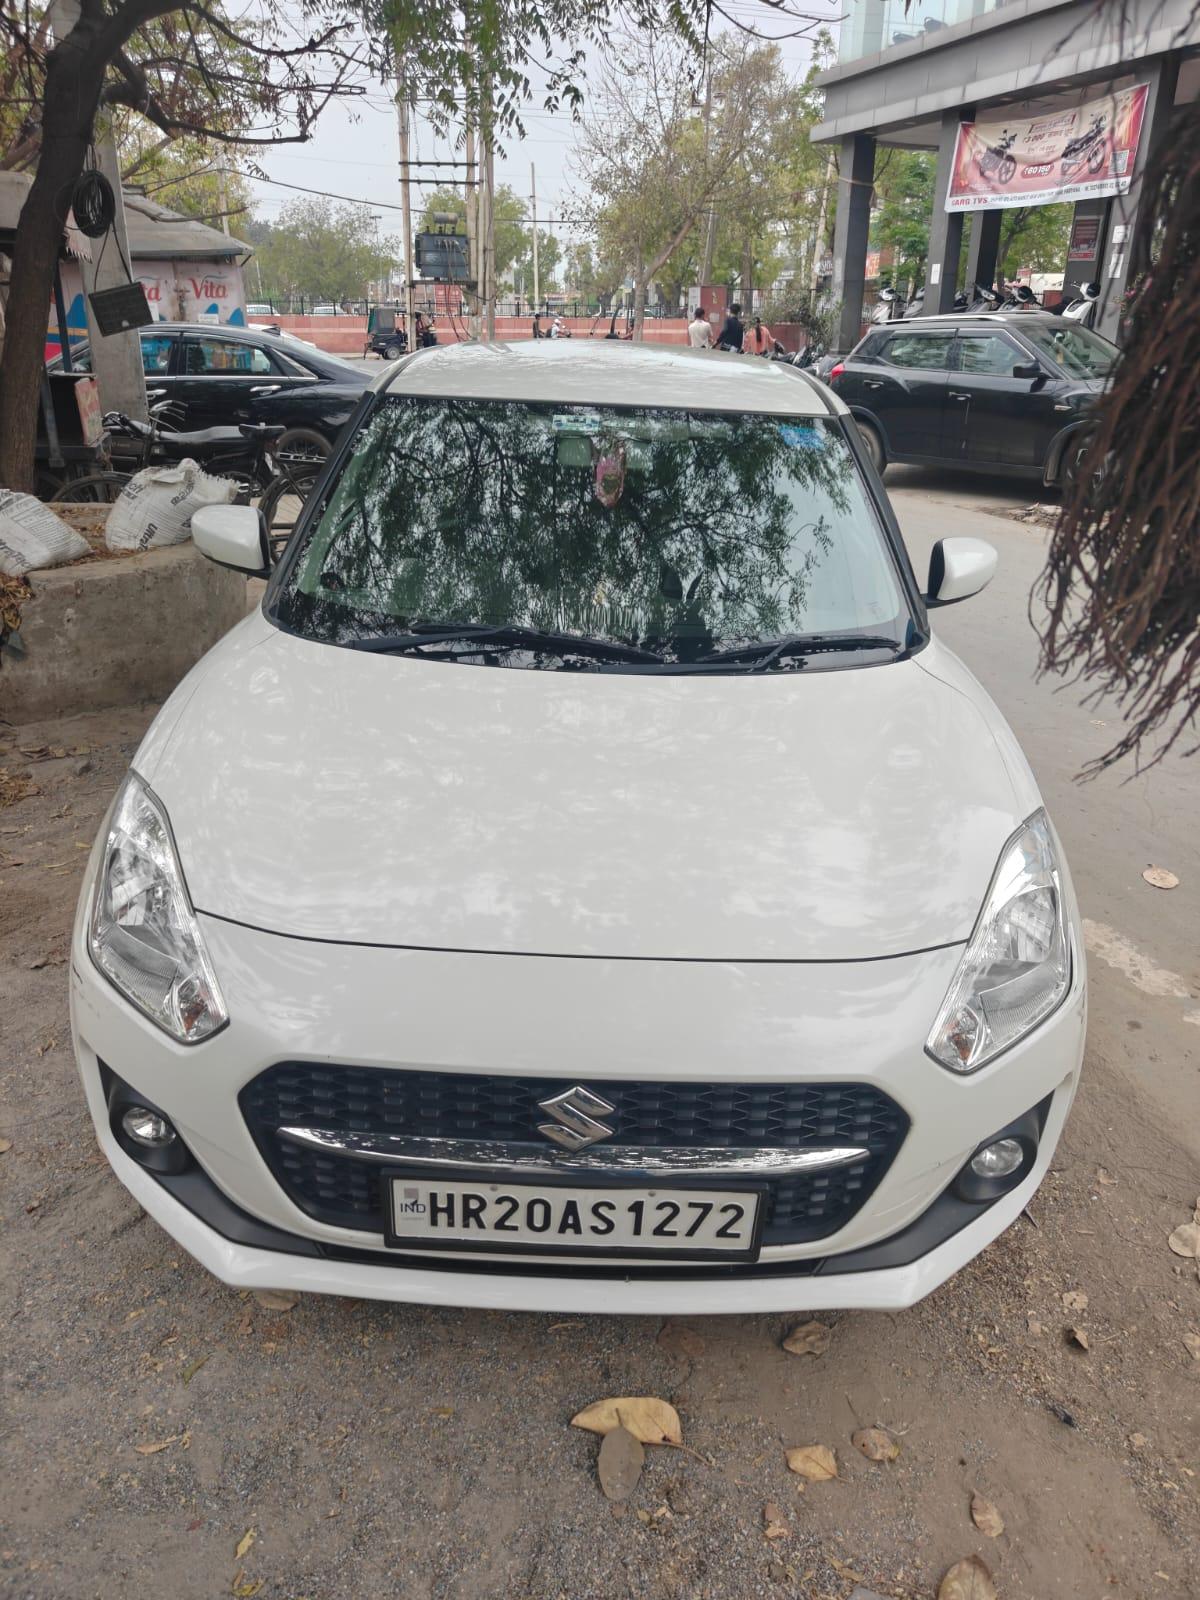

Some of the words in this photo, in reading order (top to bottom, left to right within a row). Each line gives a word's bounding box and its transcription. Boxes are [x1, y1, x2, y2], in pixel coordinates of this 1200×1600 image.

[187, 277, 228, 299] Vita
[400, 1201, 426, 1213] IND
[429, 1192, 745, 1239] HR20AS1272
